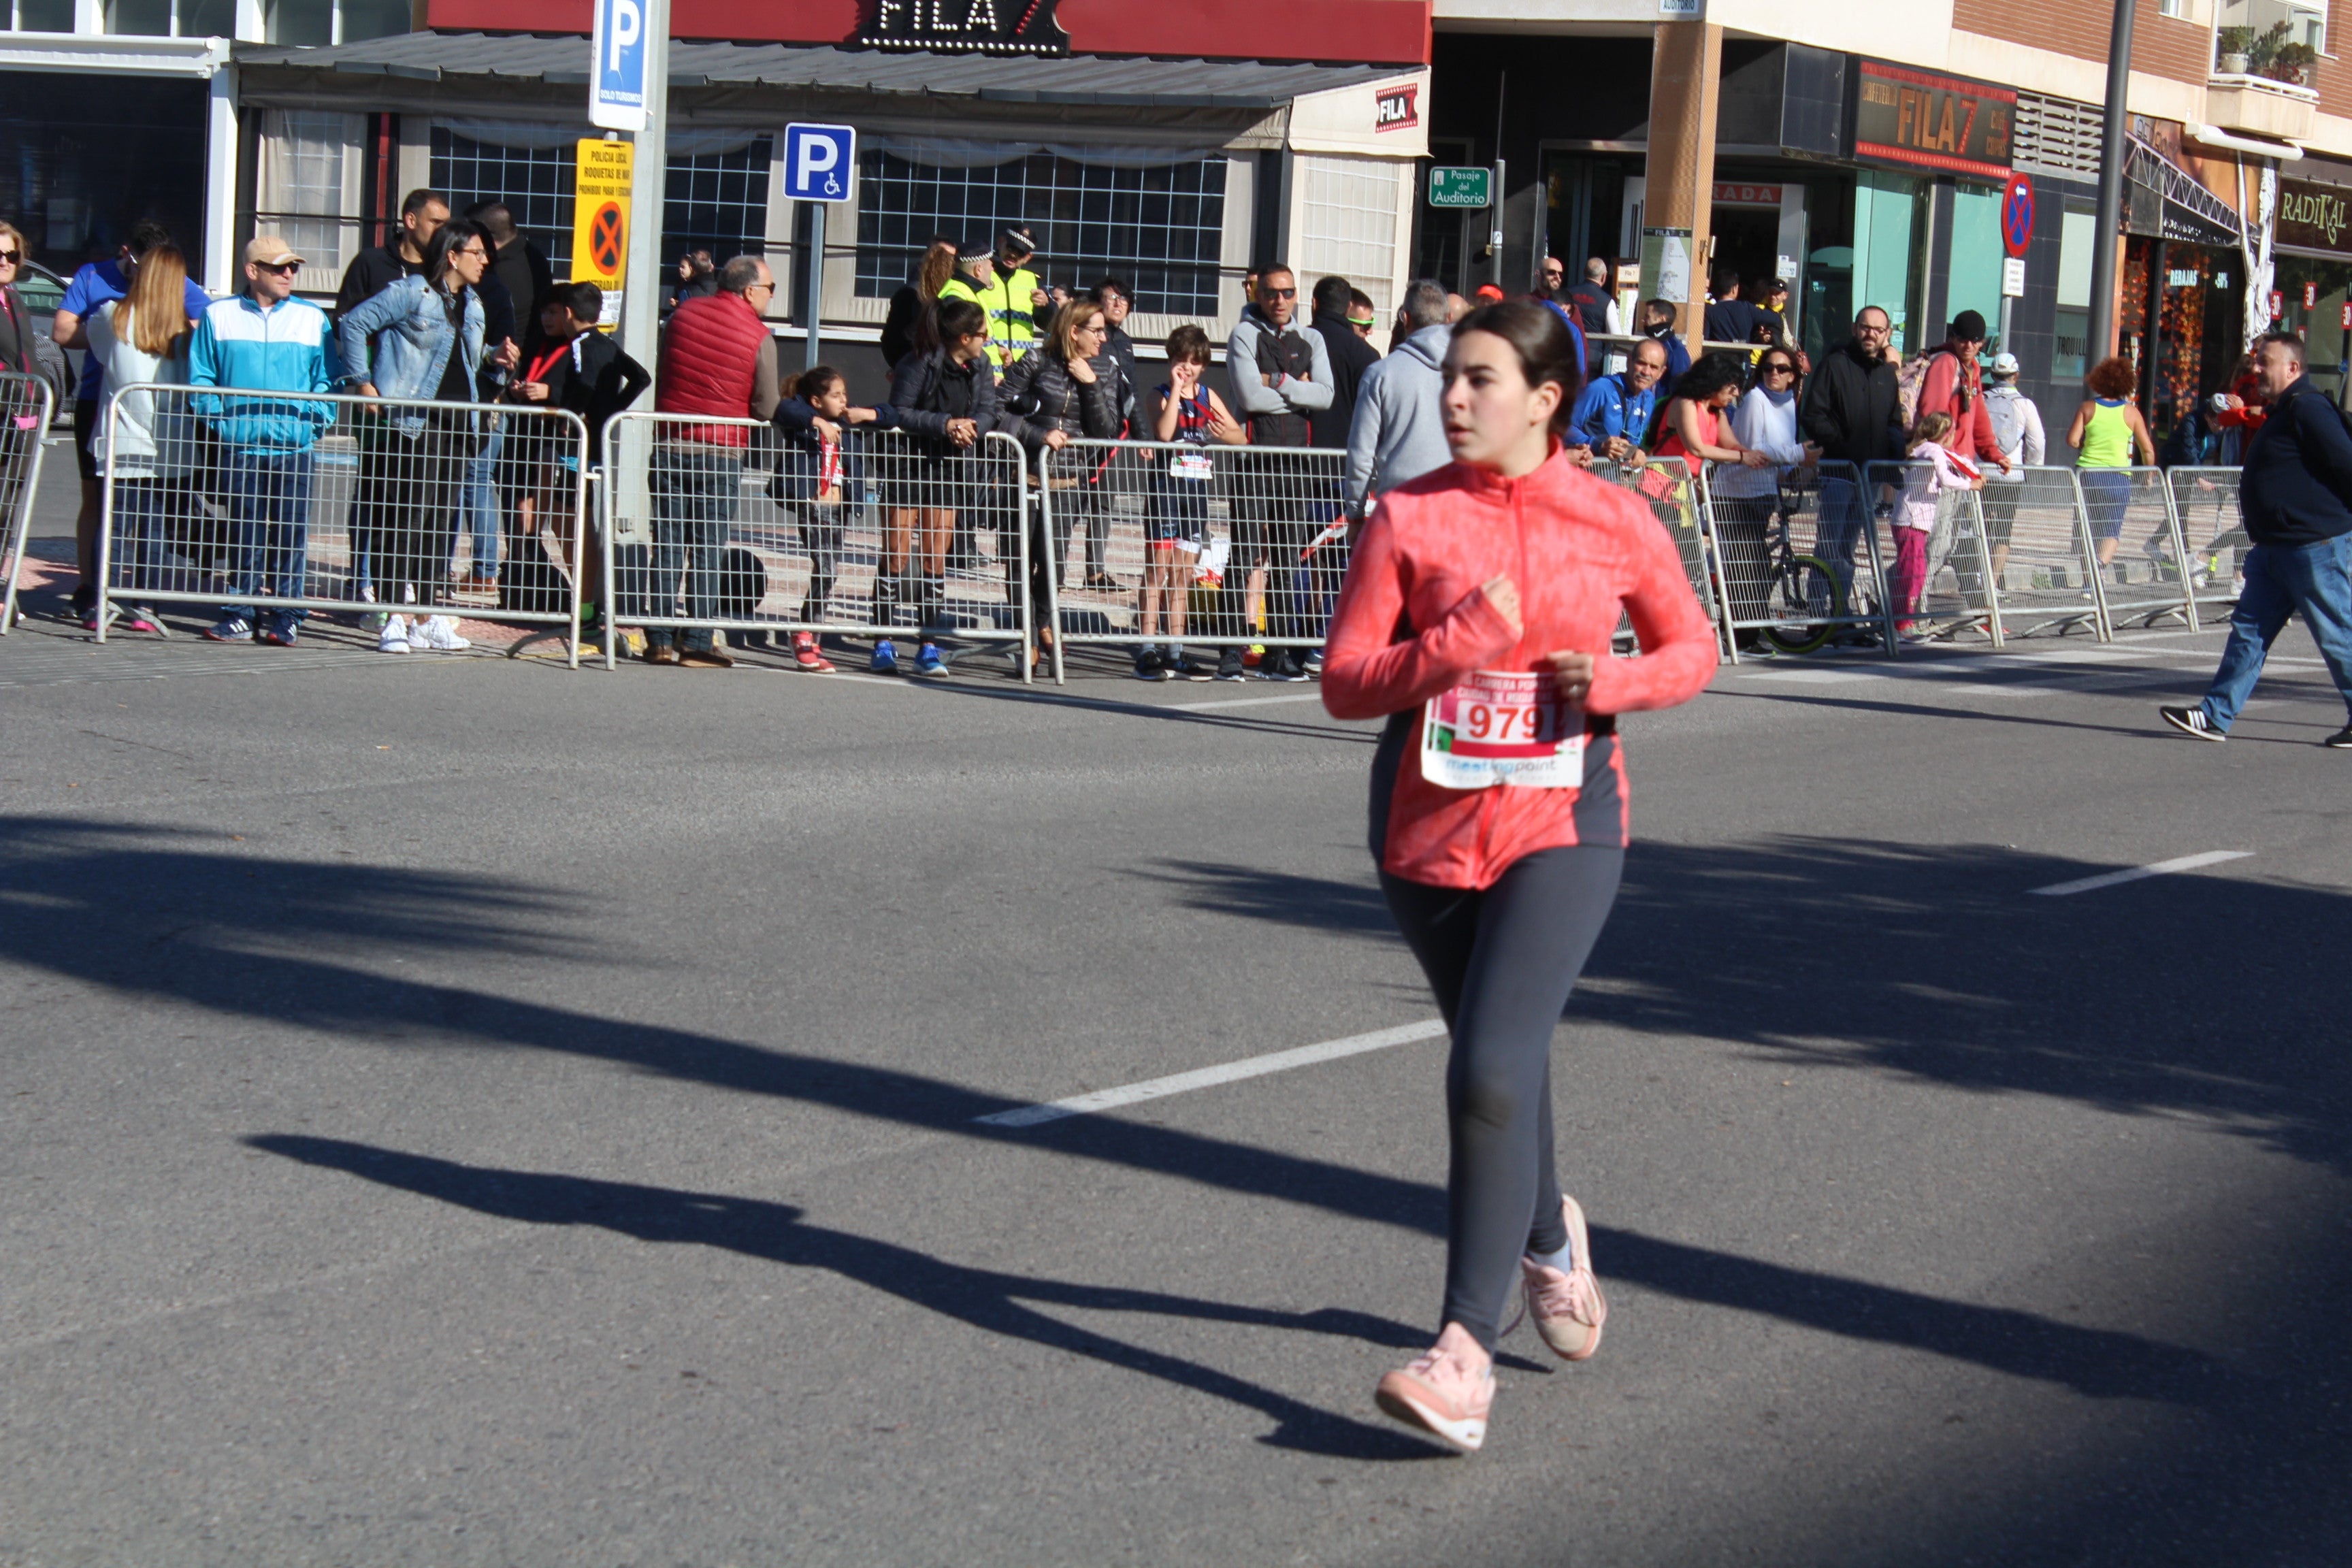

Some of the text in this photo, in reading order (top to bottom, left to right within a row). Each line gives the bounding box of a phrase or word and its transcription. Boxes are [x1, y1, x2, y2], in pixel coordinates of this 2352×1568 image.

[610, 0, 640, 71] P
[600, 89, 642, 103] SOLO TURISMOS
[797, 133, 838, 191] P
[585, 167, 615, 179] ROQUETAS
[1451, 170, 1480, 182] Pasaje
[1458, 182, 1469, 191] del
[1435, 191, 1485, 203] Auditorio
[2282, 193, 2347, 245] RADIKAL
[2170, 270, 2198, 287] REBAJAS
[1469, 704, 1544, 739] 979
